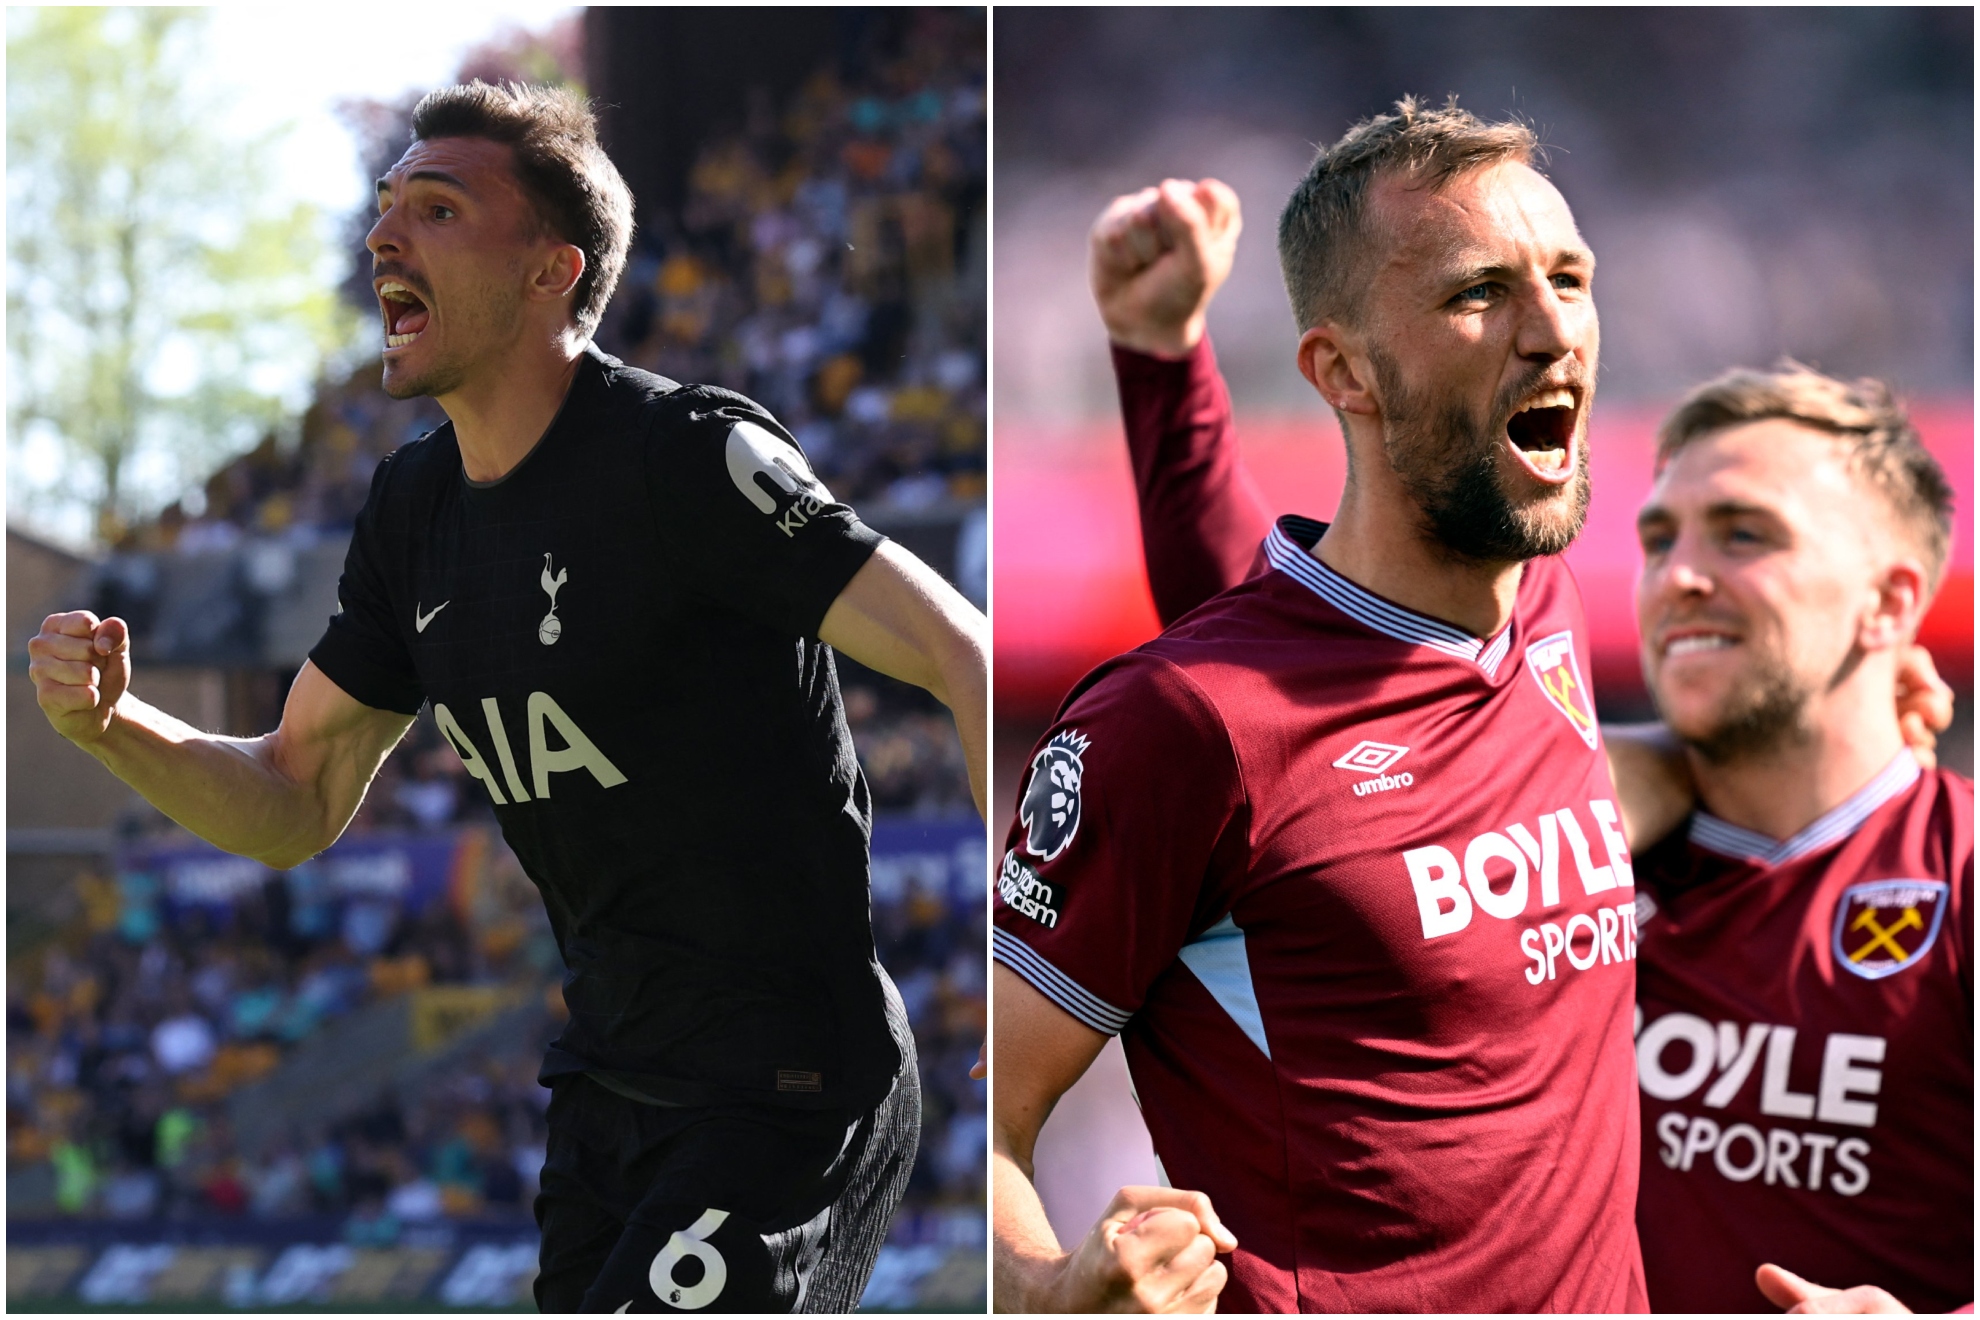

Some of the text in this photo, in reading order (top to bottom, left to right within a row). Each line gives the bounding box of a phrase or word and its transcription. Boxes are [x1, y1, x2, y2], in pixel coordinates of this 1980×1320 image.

[775, 492, 826, 538] kra
[434, 691, 629, 805] AIA
[1352, 771, 1414, 797] umbro
[1402, 799, 1635, 940] BOYLE
[1634, 1002, 1887, 1128] OYLE
[1656, 1111, 1872, 1197] SPORTS
[649, 1207, 731, 1310] 6
